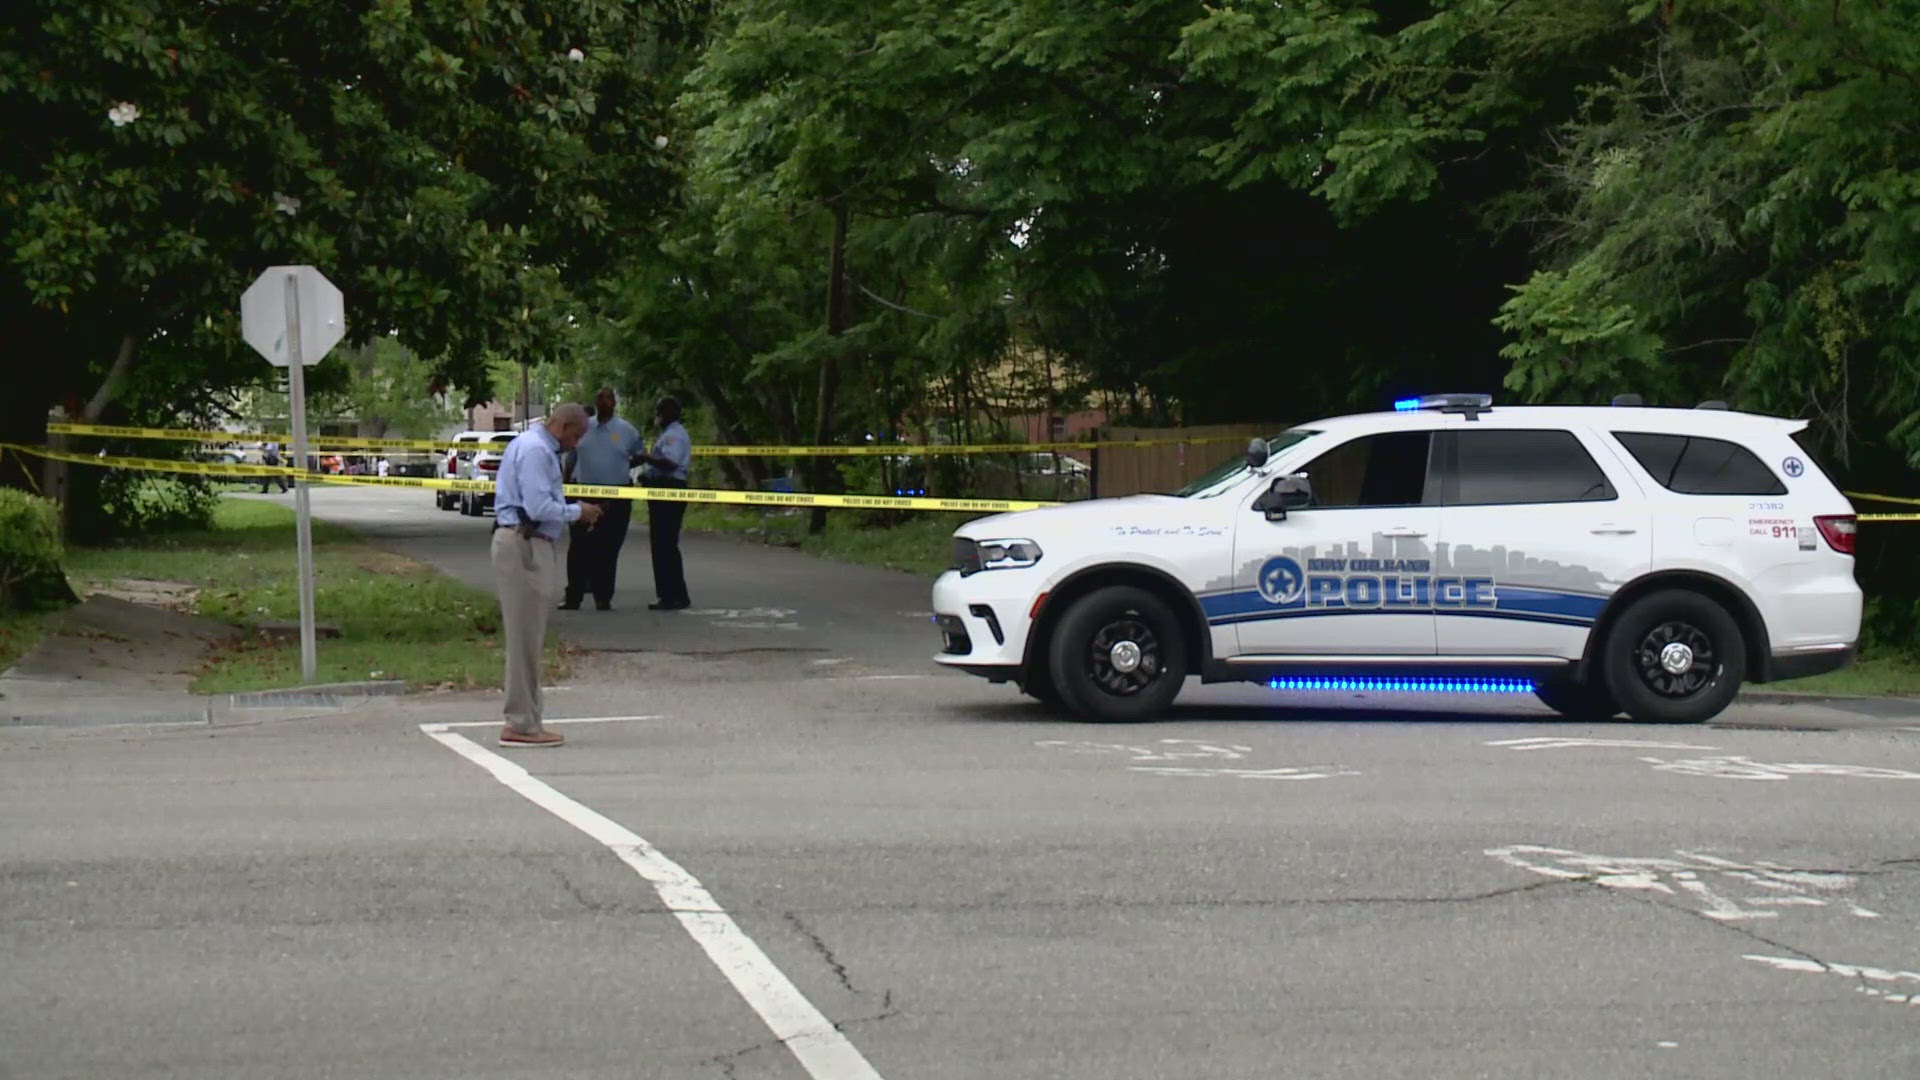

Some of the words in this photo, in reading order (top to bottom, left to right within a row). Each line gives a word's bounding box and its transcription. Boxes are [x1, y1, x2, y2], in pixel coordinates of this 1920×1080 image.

[1130, 525, 1161, 536] Protect
[1772, 525, 1797, 538] 911
[1307, 558, 1346, 572] NEW
[1351, 559, 1430, 573] ORLEANS
[1305, 573, 1498, 608] POLICE
